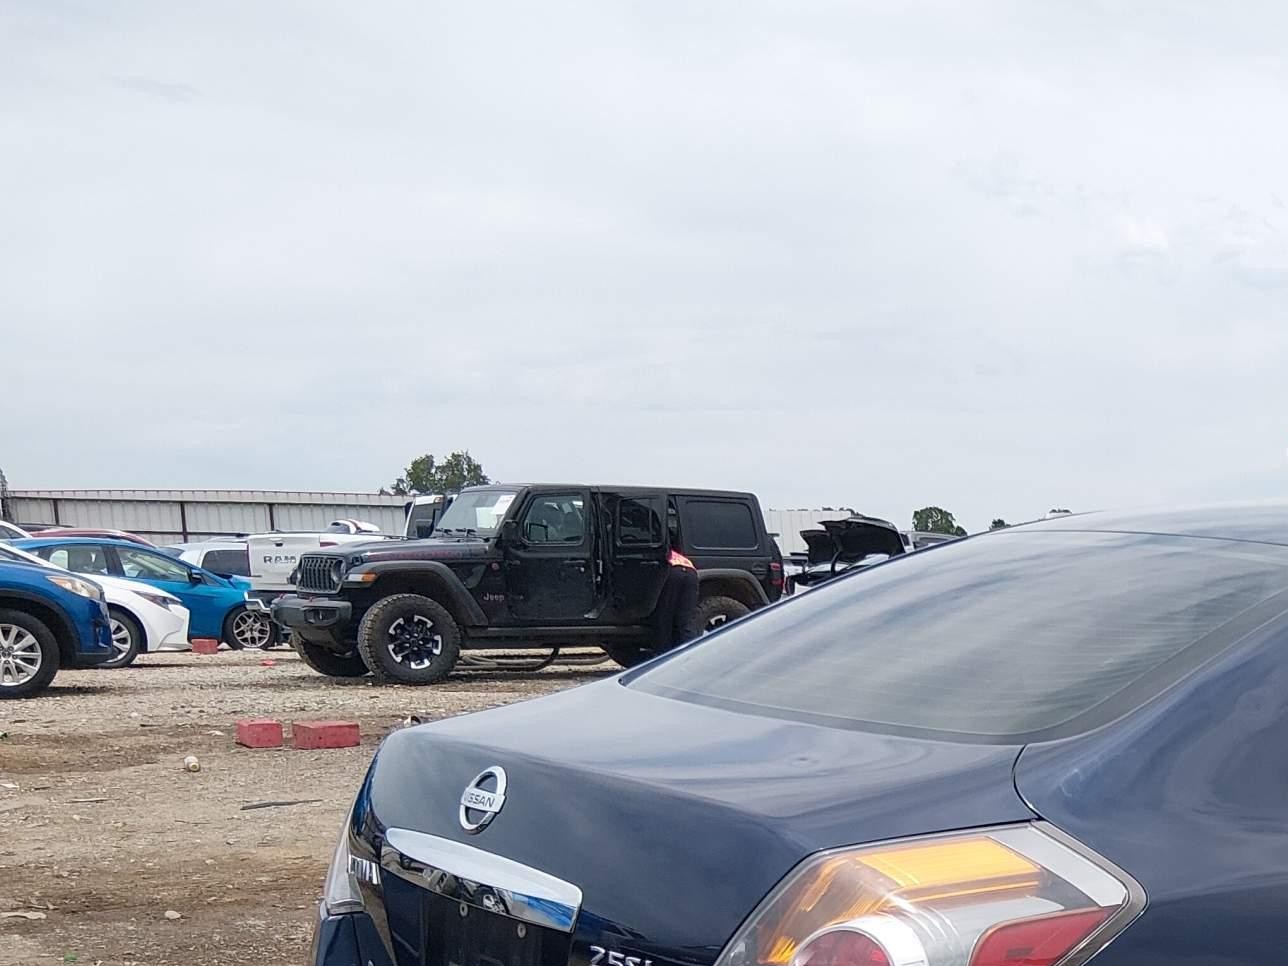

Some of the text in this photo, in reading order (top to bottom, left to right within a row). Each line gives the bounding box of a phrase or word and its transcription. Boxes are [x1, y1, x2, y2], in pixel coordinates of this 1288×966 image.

[263, 555, 297, 564] RAM
[483, 592, 505, 603] Jeep
[464, 791, 496, 808] SSAN
